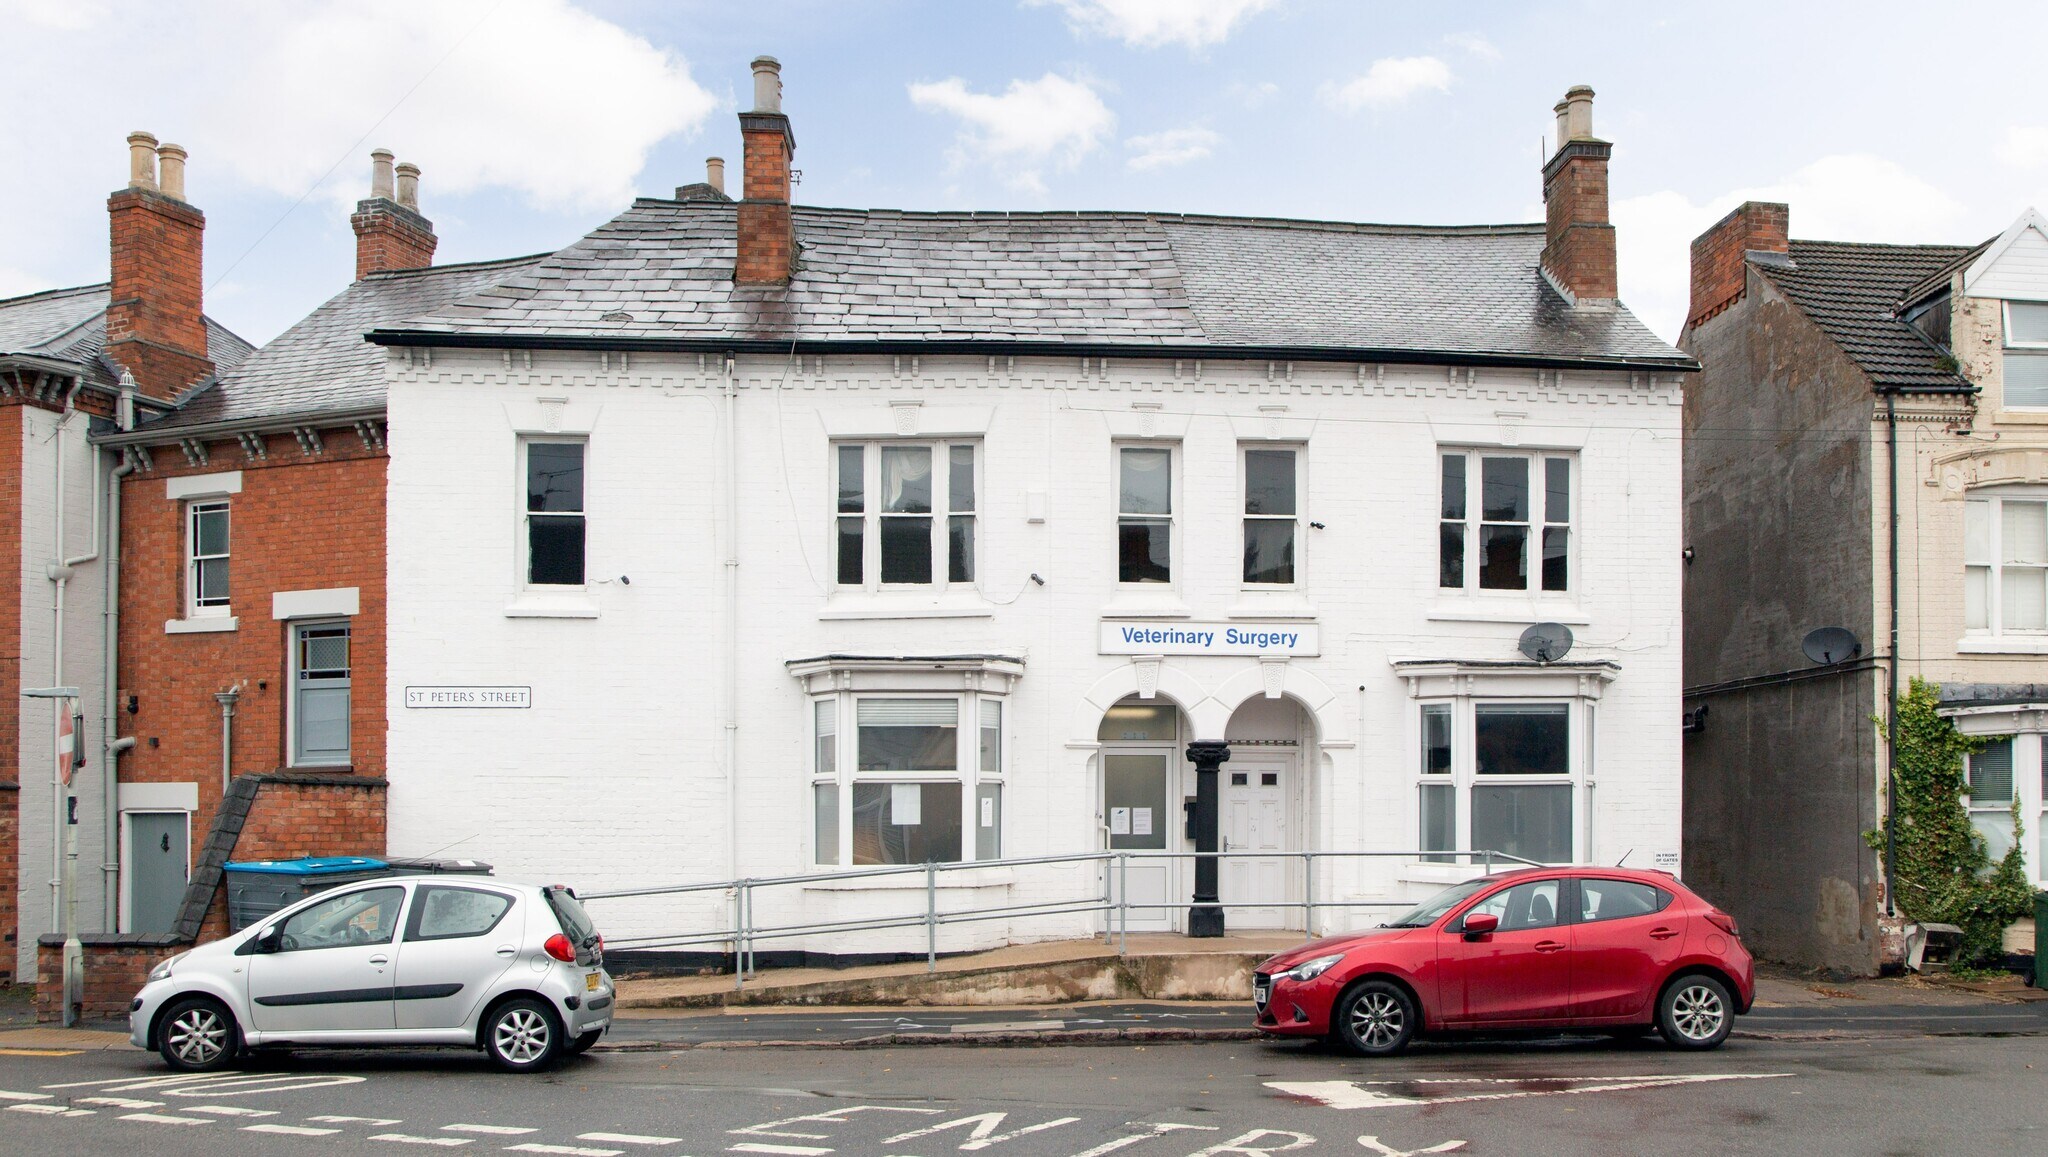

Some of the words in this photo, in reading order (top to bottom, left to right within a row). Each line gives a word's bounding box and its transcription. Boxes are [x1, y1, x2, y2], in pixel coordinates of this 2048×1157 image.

[1122, 627, 1214, 647] Veterinary
[1226, 628, 1298, 648] Surgery
[409, 692, 424, 702] ST
[431, 692, 475, 702] PETERS
[481, 692, 526, 702] STREET
